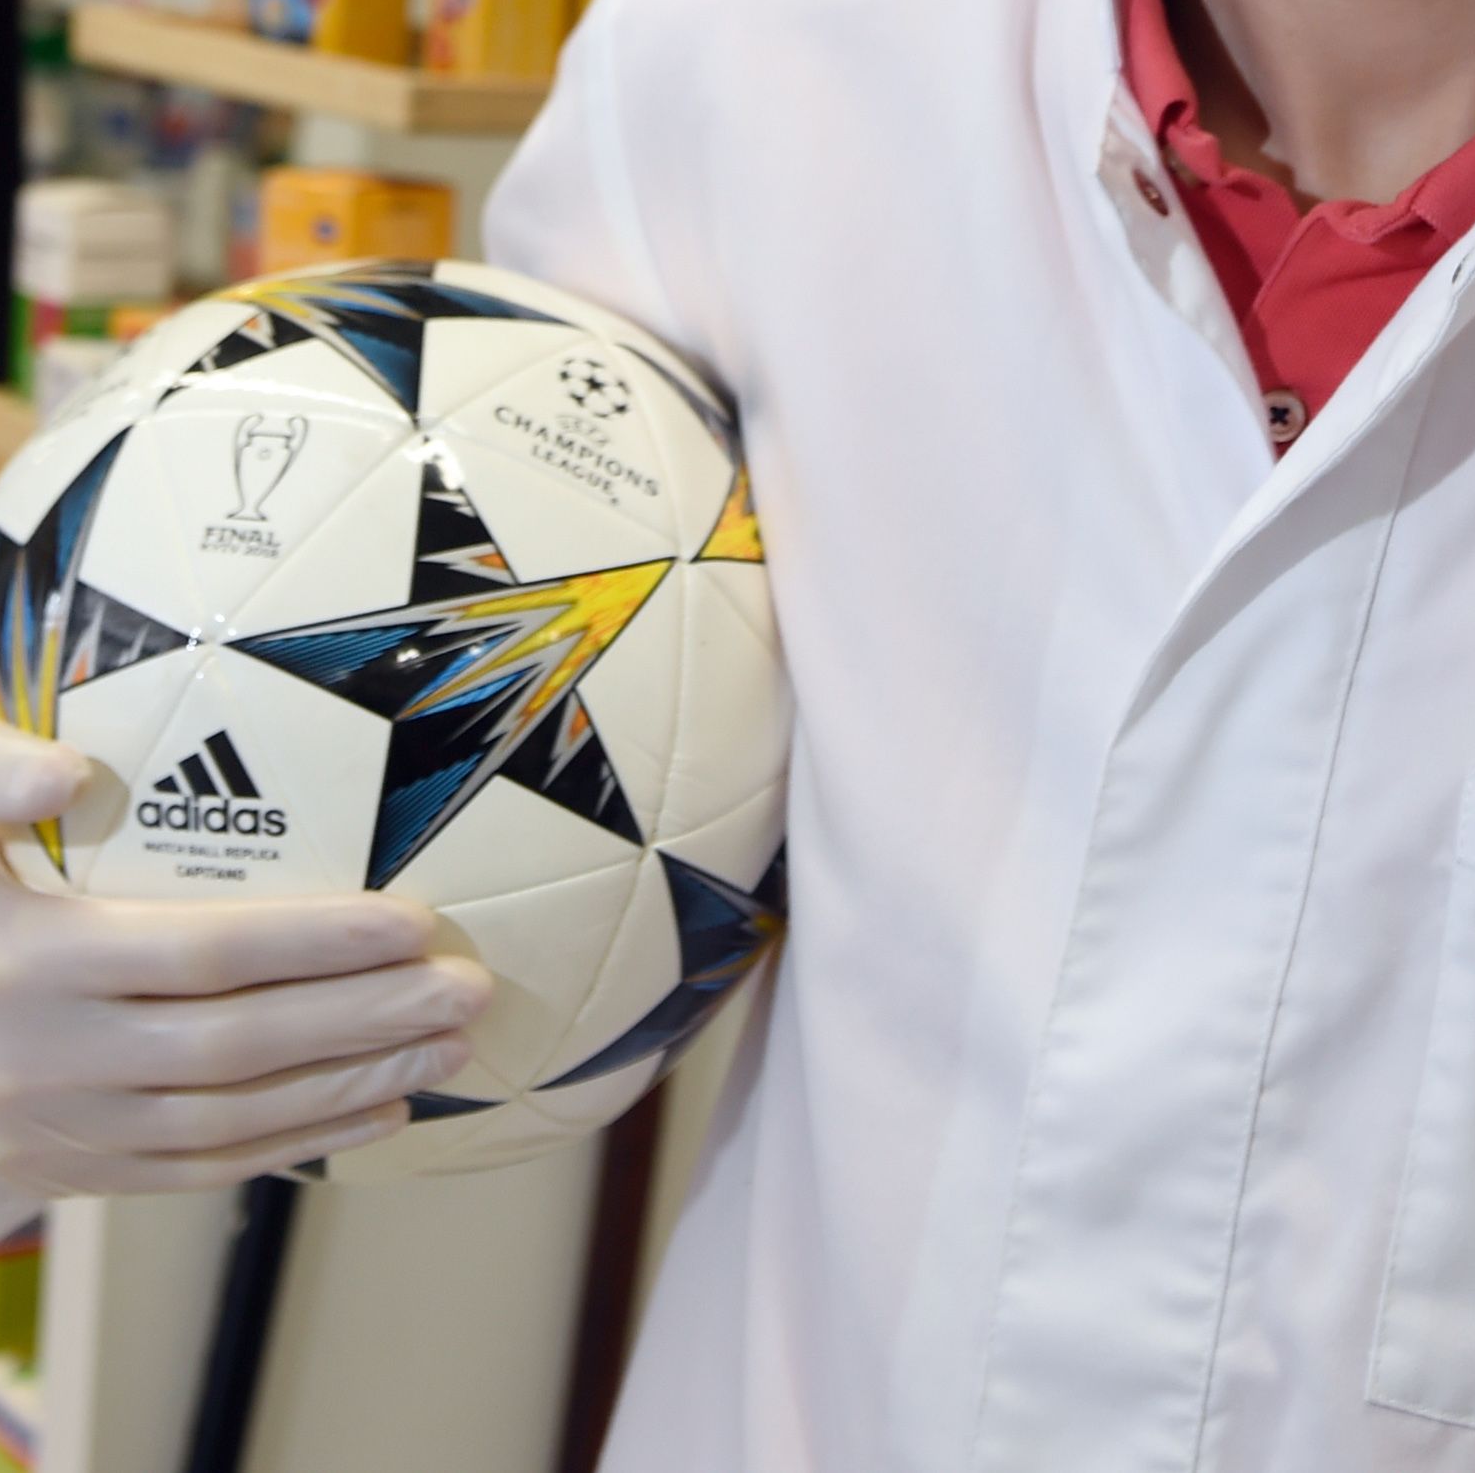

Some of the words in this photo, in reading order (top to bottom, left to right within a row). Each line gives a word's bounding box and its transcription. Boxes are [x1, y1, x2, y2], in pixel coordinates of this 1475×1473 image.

[494, 406, 660, 498] CHAMPIONS
[204, 526, 282, 547] FINAL
[137, 797, 288, 837] adidas
[188, 844, 220, 858] BALL
[225, 846, 281, 861] REPLICA
